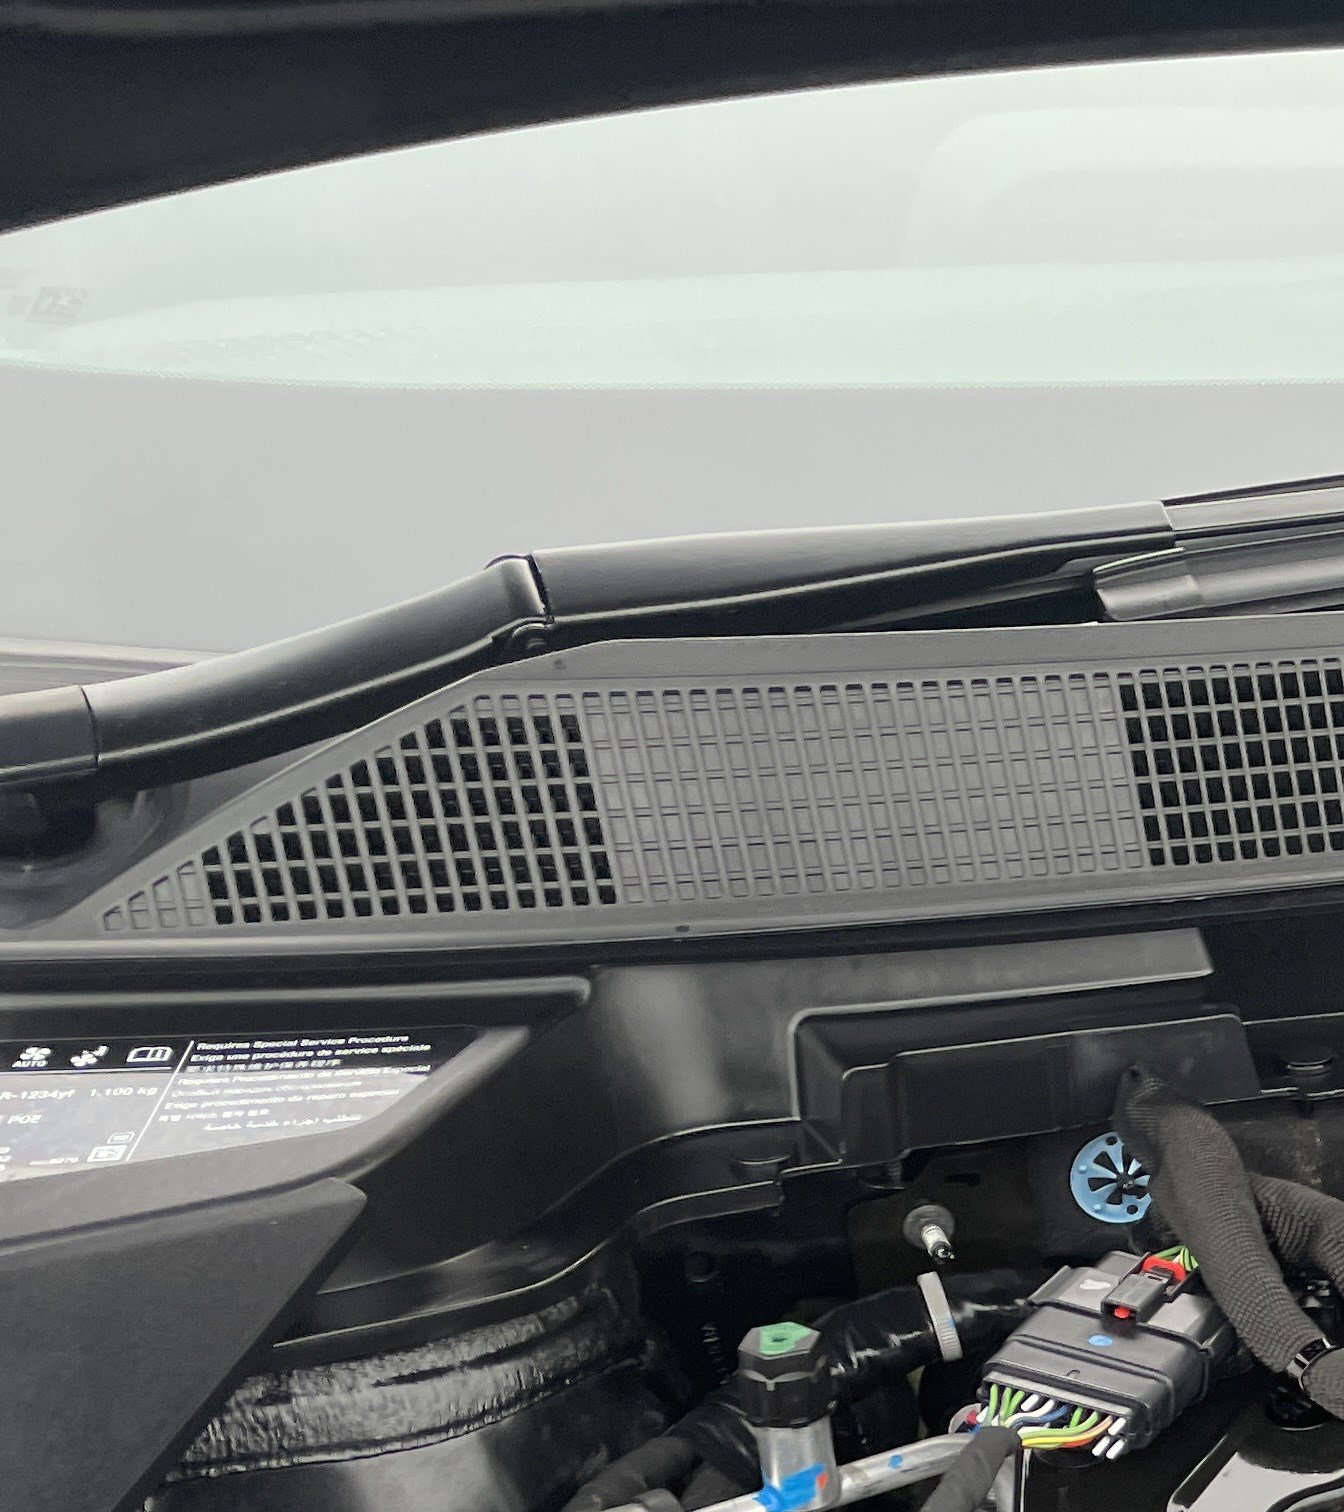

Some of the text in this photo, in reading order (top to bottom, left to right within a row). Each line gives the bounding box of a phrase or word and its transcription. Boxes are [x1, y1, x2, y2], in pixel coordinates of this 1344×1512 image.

[197, 1035, 409, 1052] Requires Special Service Procedure
[12, 1060, 48, 1068] AUTO
[137, 1086, 158, 1096] kg
[7, 1114, 42, 1125] POE
